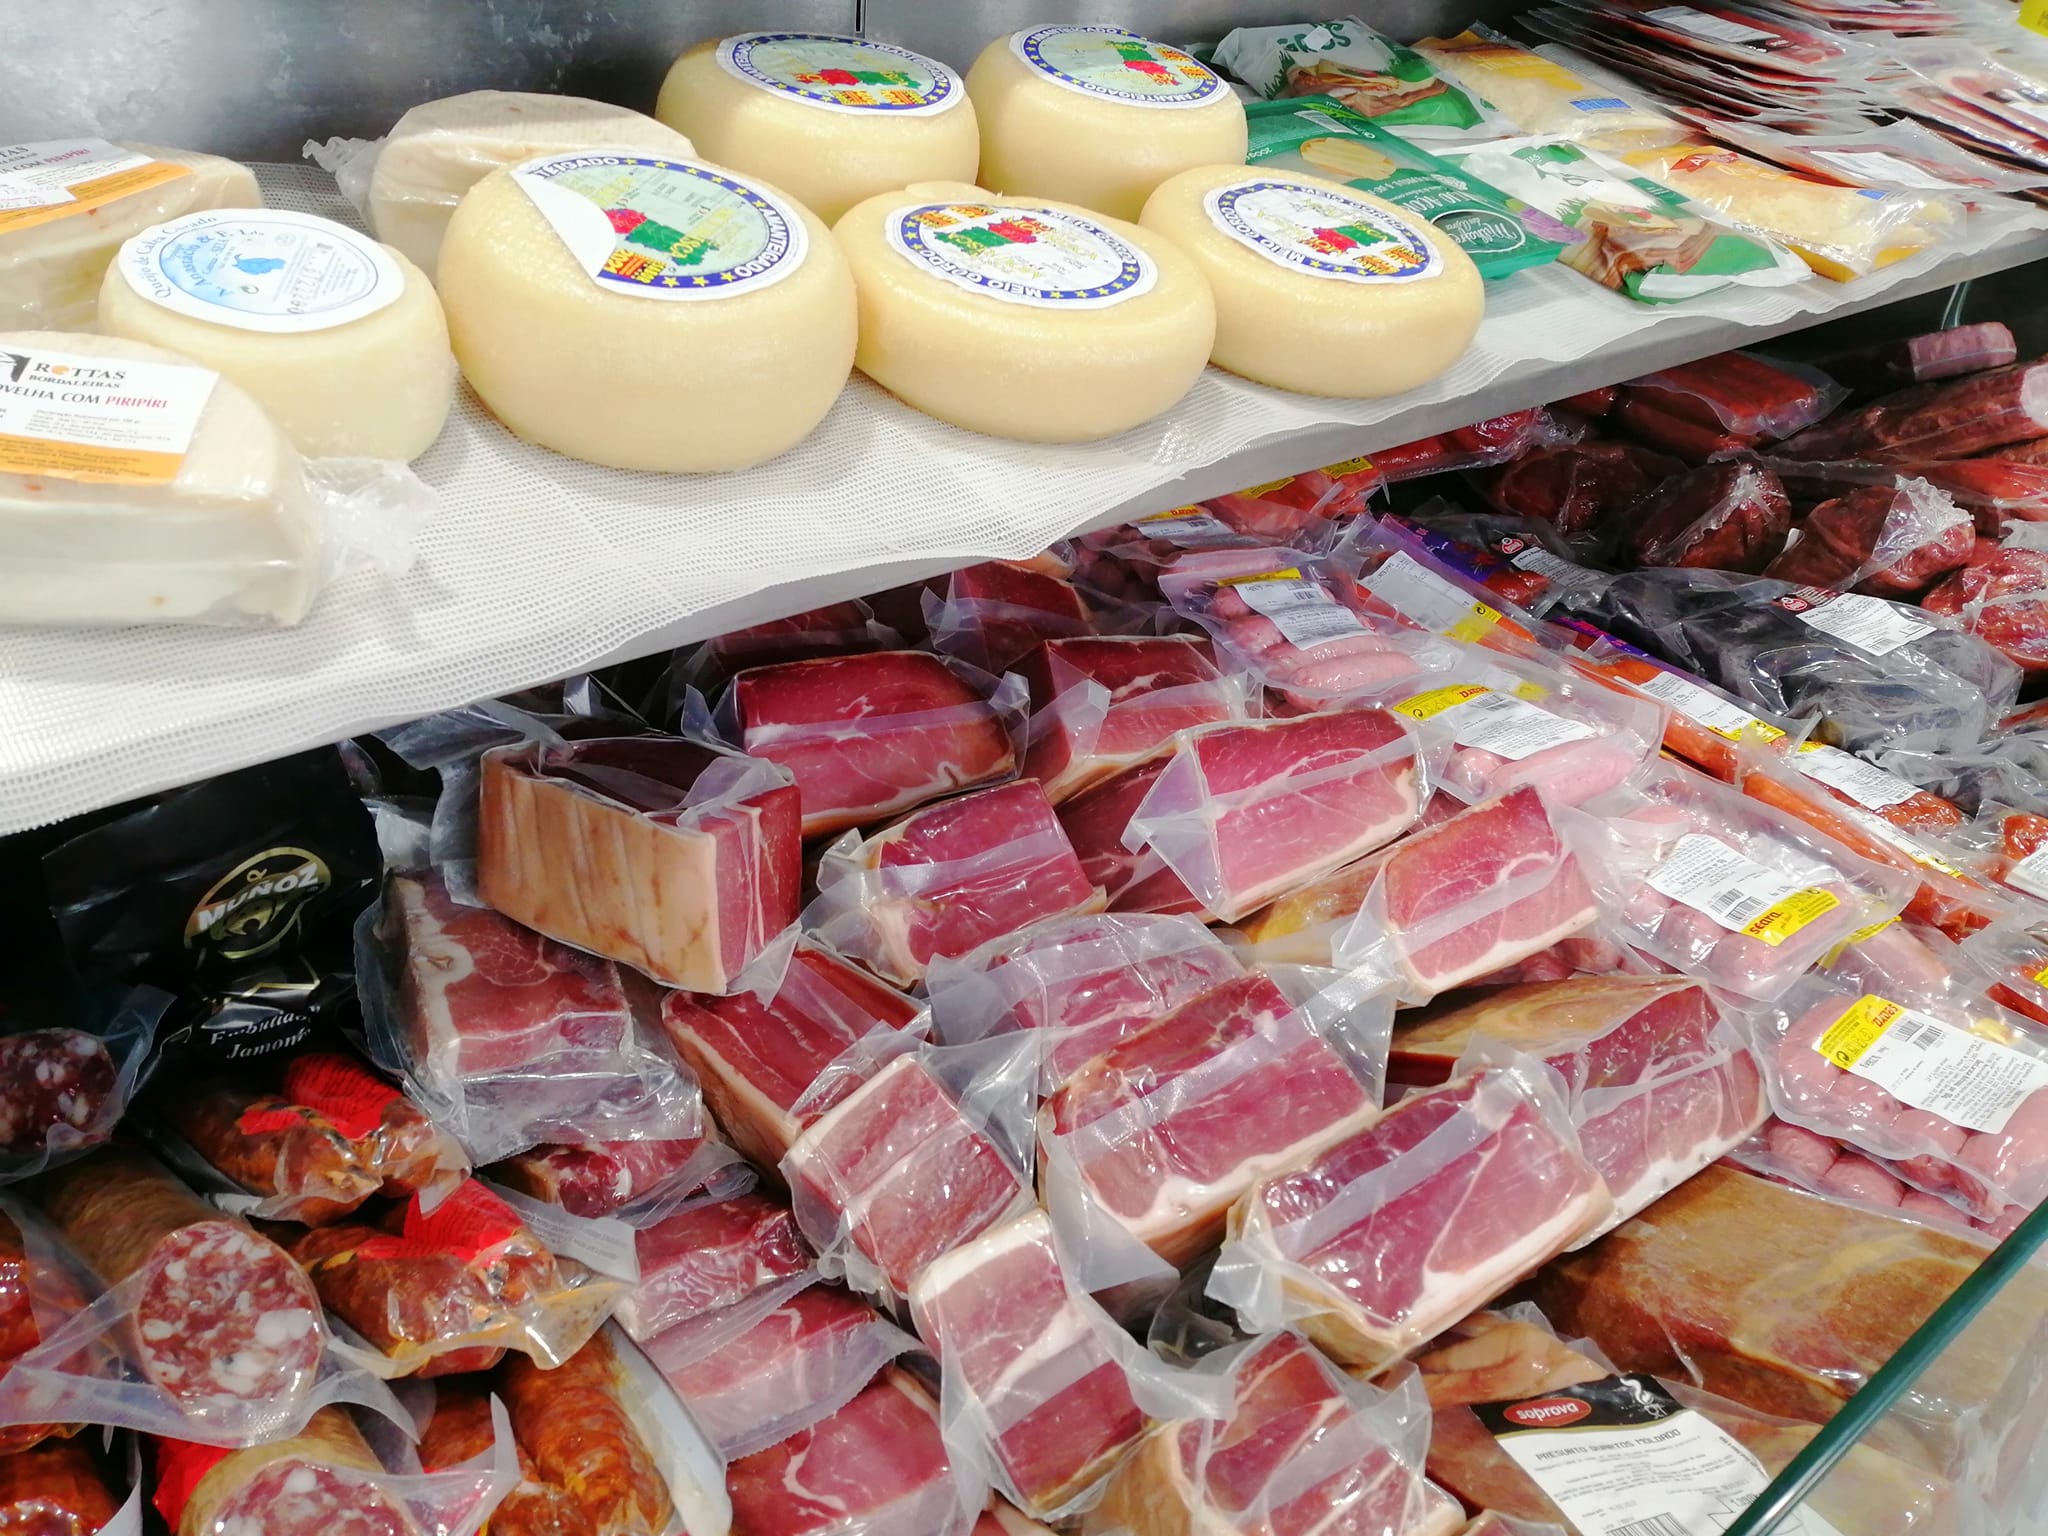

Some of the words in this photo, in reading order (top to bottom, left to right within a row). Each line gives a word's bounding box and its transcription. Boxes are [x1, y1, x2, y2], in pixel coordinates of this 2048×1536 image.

[1084, 82, 1195, 103] AMANTEIGADO
[532, 157, 619, 181] TEIGADO
[737, 207, 788, 278] AMANTEIGADO
[919, 249, 985, 287] GORDO
[987, 278, 1042, 299] MEIO
[29, 374, 121, 389] BORDALEIRAS
[60, 392, 100, 405] COM
[197, 863, 320, 931] MUÑOZ
[1749, 911, 1784, 935] seara
[1872, 1003, 1899, 1028] seara
[1516, 1400, 1579, 1422] soprova
[1536, 1445, 1587, 1462] PRESUNTO
